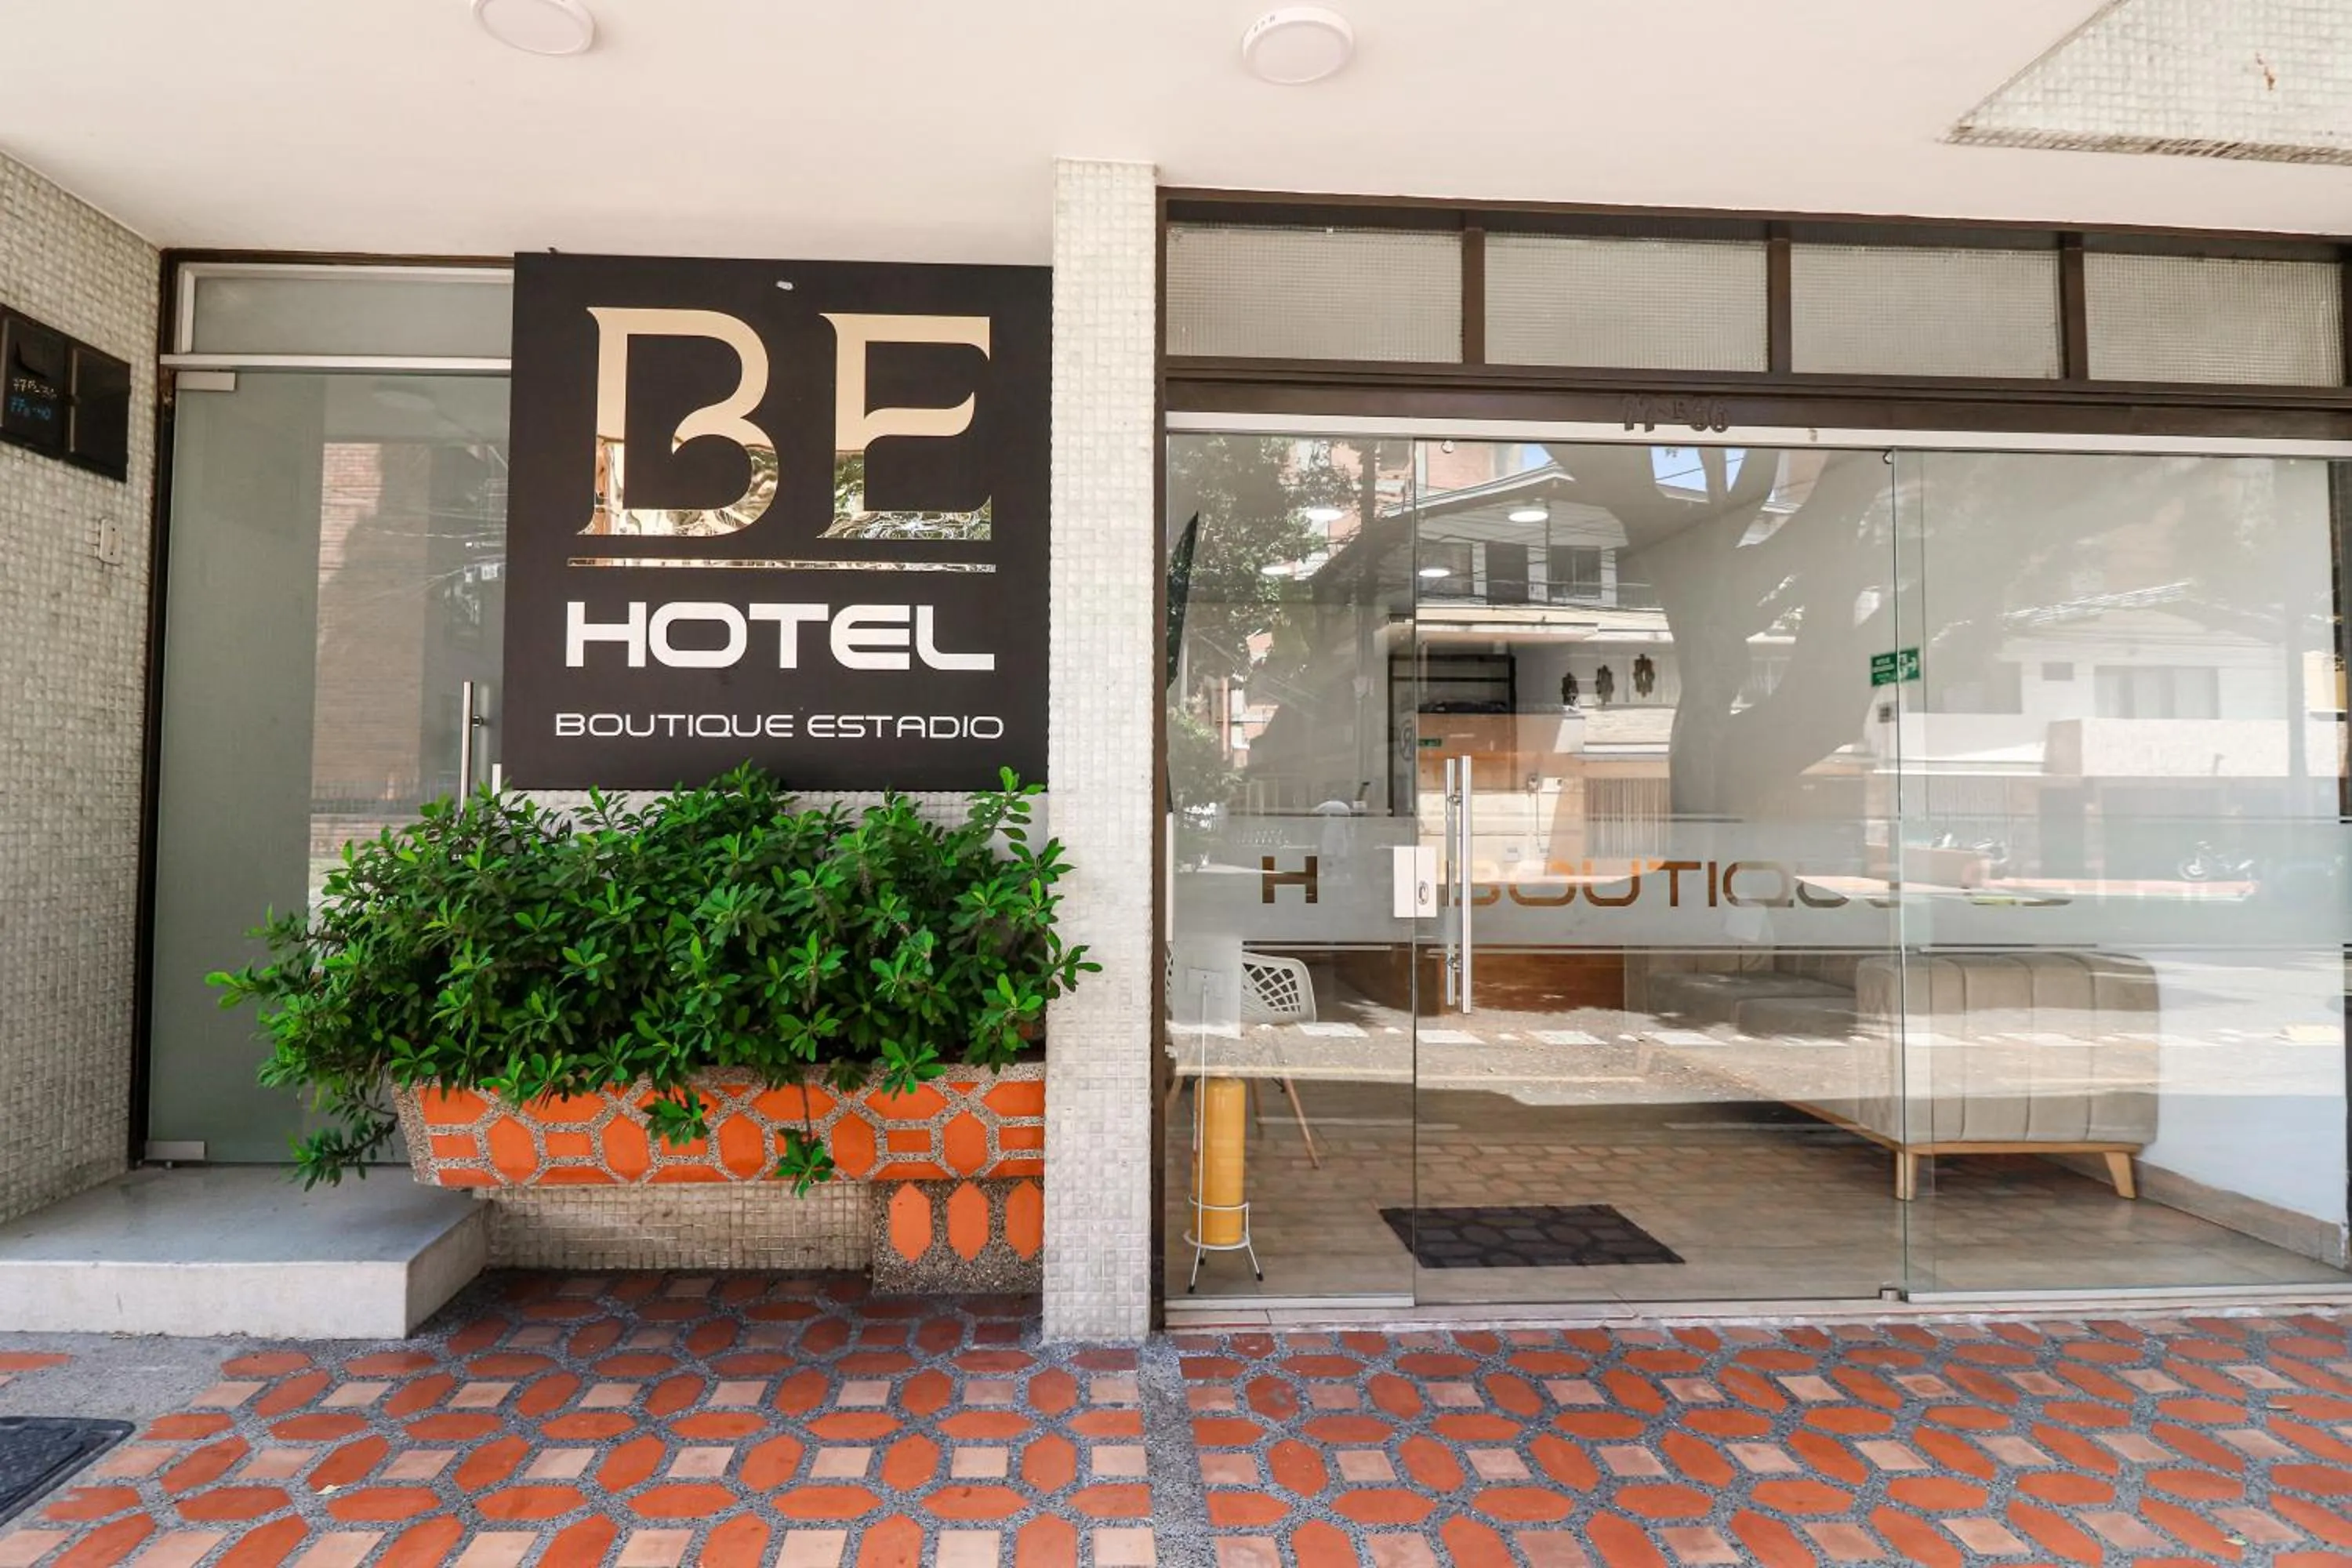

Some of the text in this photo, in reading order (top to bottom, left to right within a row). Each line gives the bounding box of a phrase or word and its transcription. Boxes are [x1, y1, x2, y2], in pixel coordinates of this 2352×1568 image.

[576, 307, 993, 540] BE
[565, 601, 995, 670] HOTEL
[555, 713, 1004, 740] BOUTIQUE ESTADIO
